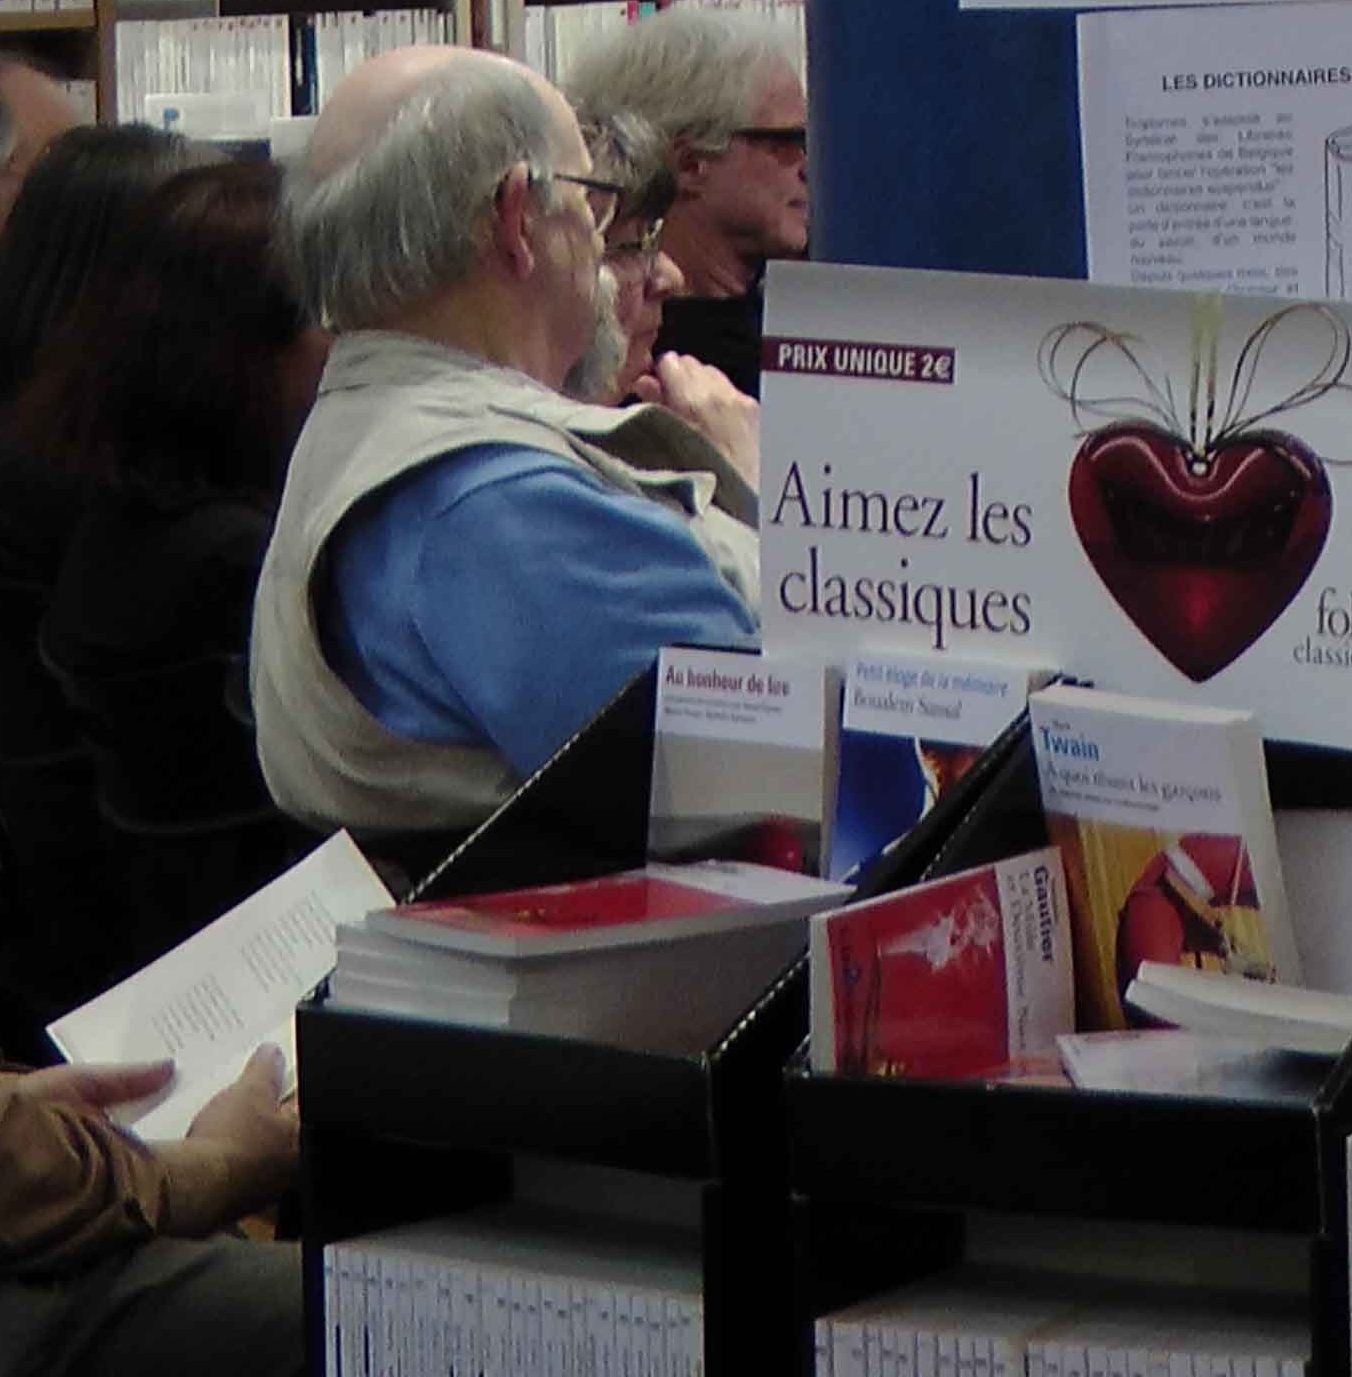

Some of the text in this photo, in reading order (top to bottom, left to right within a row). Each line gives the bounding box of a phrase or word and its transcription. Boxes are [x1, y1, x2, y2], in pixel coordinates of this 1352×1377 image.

[1162, 73, 1197, 92] LES
[1203, 66, 1352, 90] DICTIONNAIRES
[778, 342, 951, 378] PRIX UNIQUE 2€
[771, 460, 1033, 548] Aimez les
[779, 544, 1033, 650] classiques
[687, 666, 743, 692] bonheur
[747, 673, 765, 696] de
[1040, 726, 1099, 761] Twain
[1034, 865, 1054, 961] Gautier
